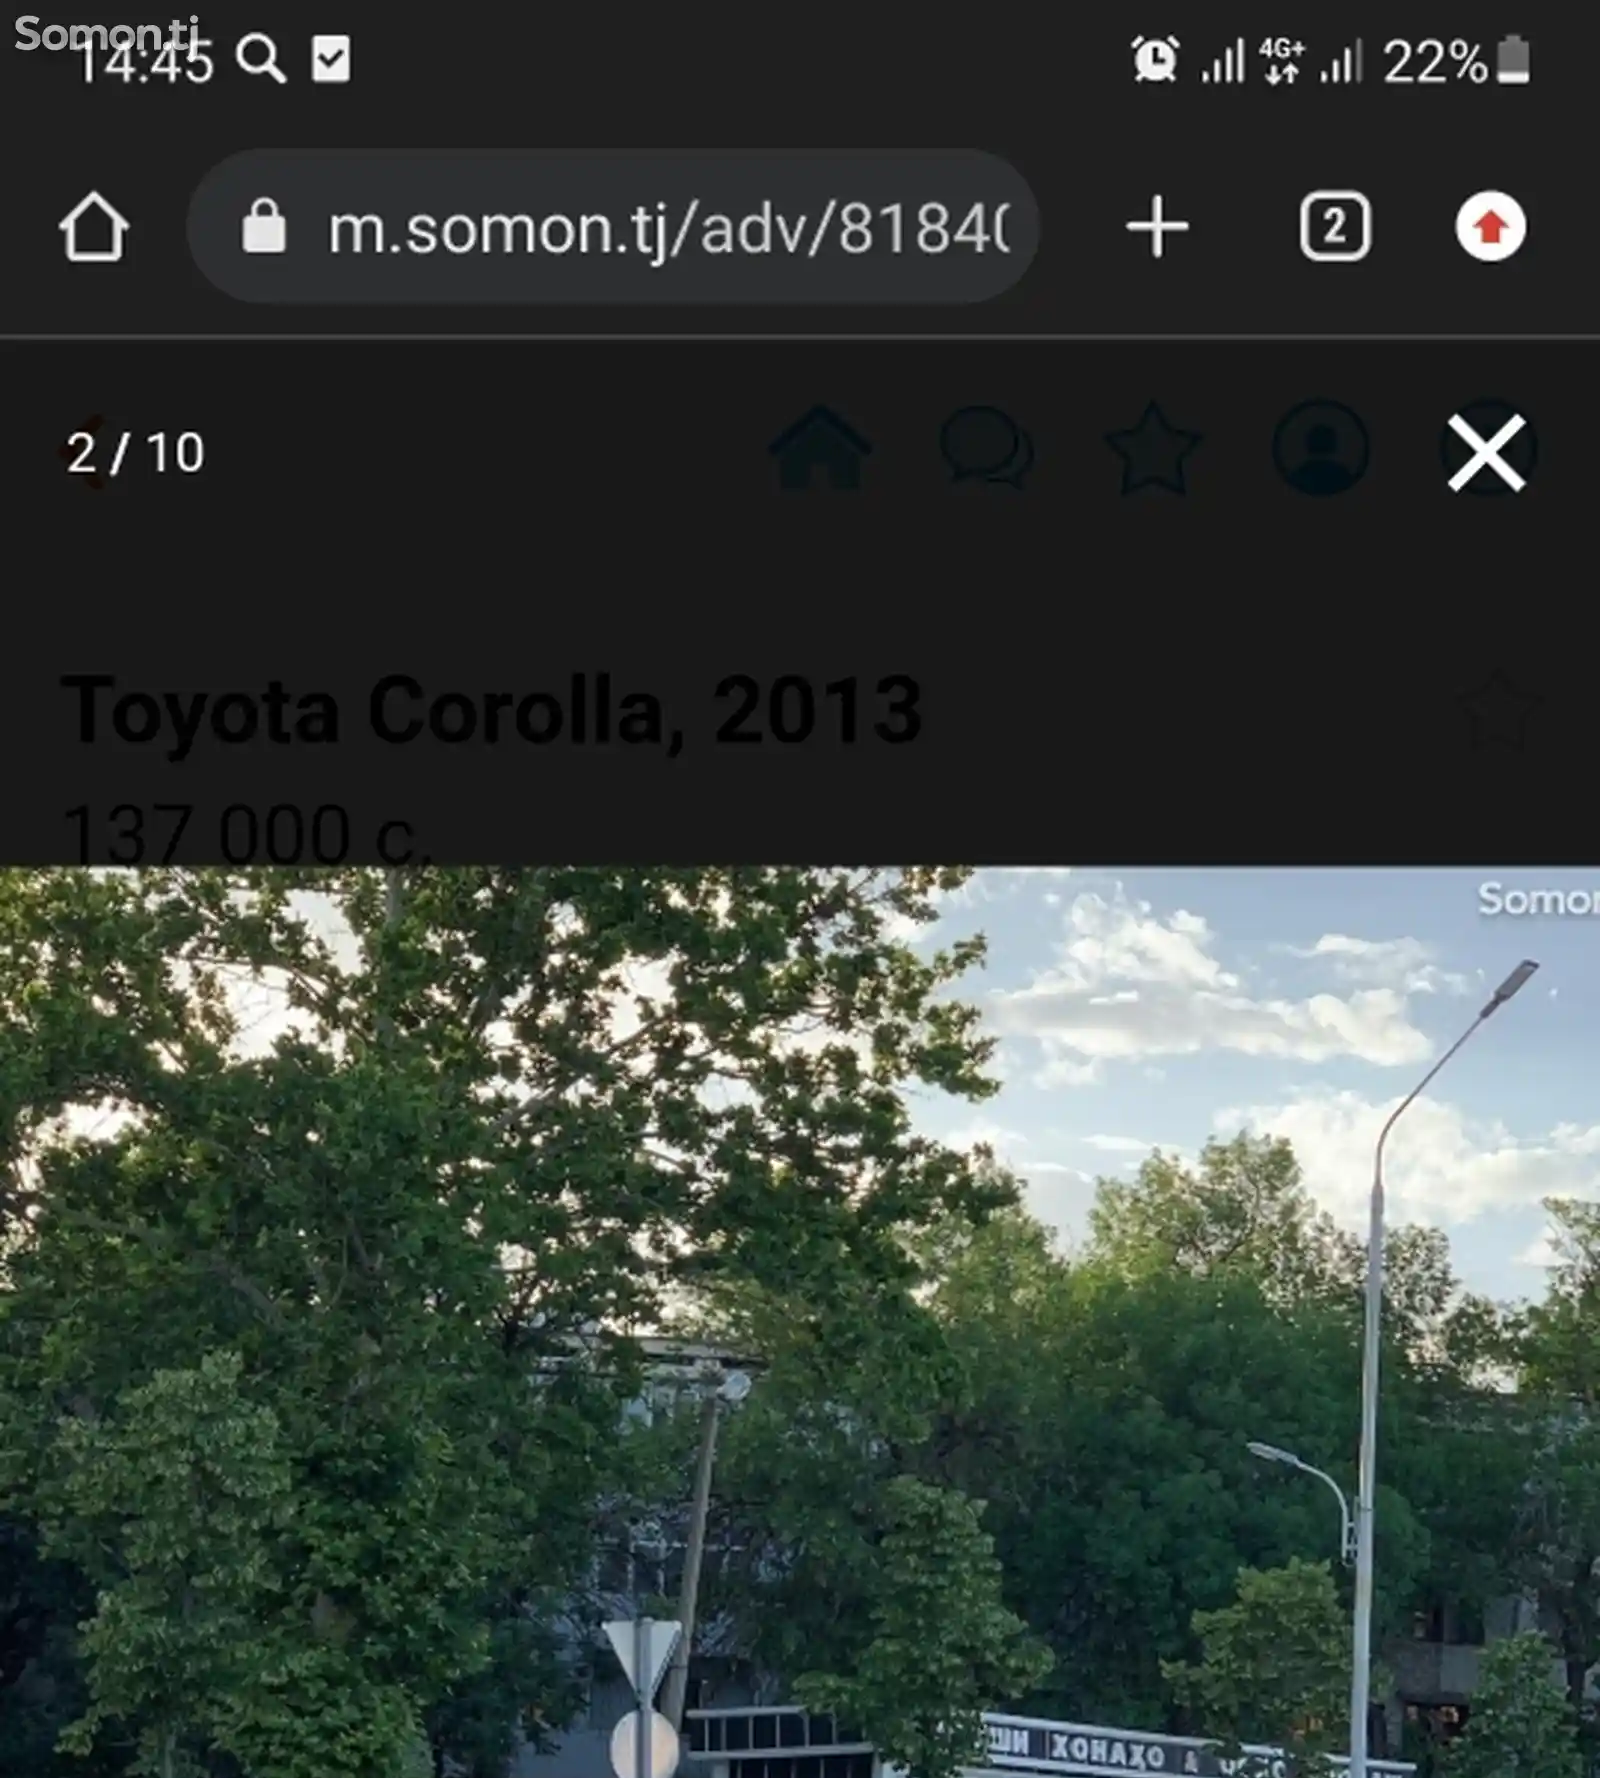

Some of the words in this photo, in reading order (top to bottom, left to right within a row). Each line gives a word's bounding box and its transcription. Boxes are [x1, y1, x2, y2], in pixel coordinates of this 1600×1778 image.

[76, 38, 214, 83] 14:45
[1259, 37, 1306, 58] 4G+
[1383, 38, 1489, 84] 22%
[1323, 206, 1347, 243] 2
[67, 431, 97, 473] 2
[147, 431, 205, 473] 10
[60, 674, 339, 764] Toyota
[369, 671, 684, 759] Corolla,
[713, 674, 923, 744] 2013
[66, 803, 193, 865] 137
[220, 803, 350, 865] 000
